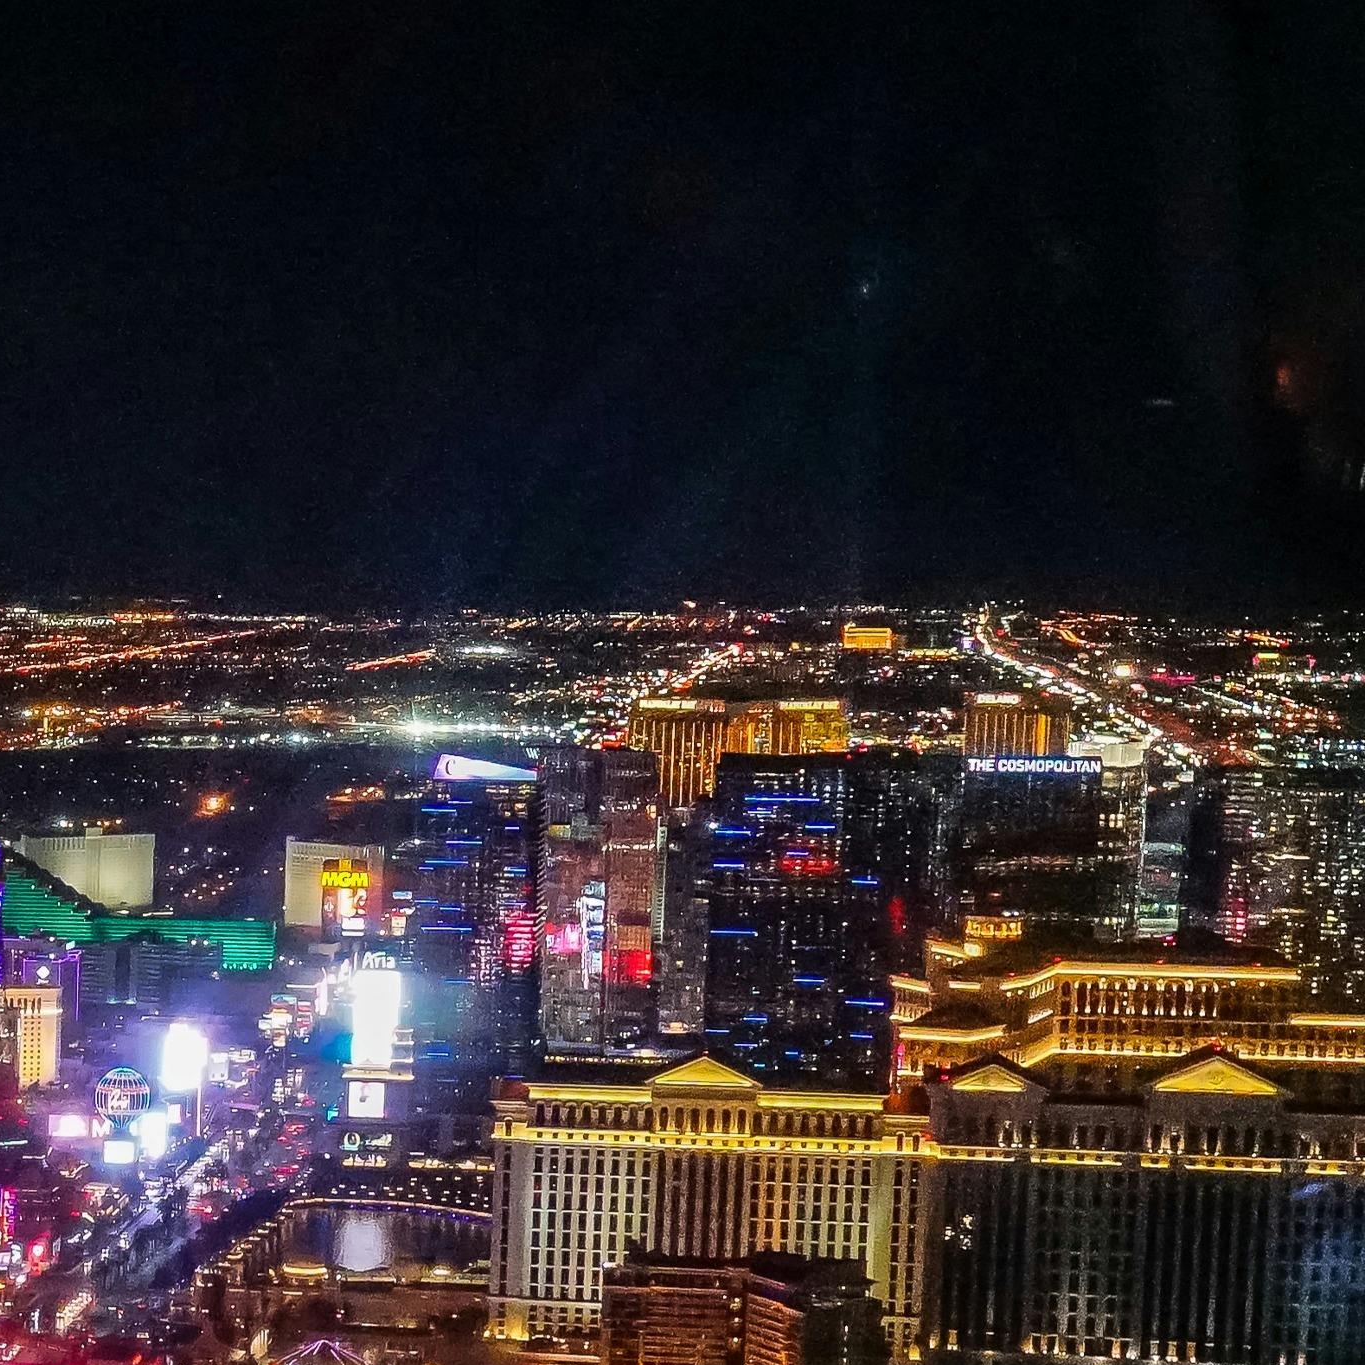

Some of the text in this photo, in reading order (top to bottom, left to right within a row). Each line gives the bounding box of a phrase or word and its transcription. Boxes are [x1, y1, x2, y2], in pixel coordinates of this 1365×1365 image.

[968, 758, 1101, 773] THE COSMOPOLITAN
[321, 871, 369, 887] MGM
